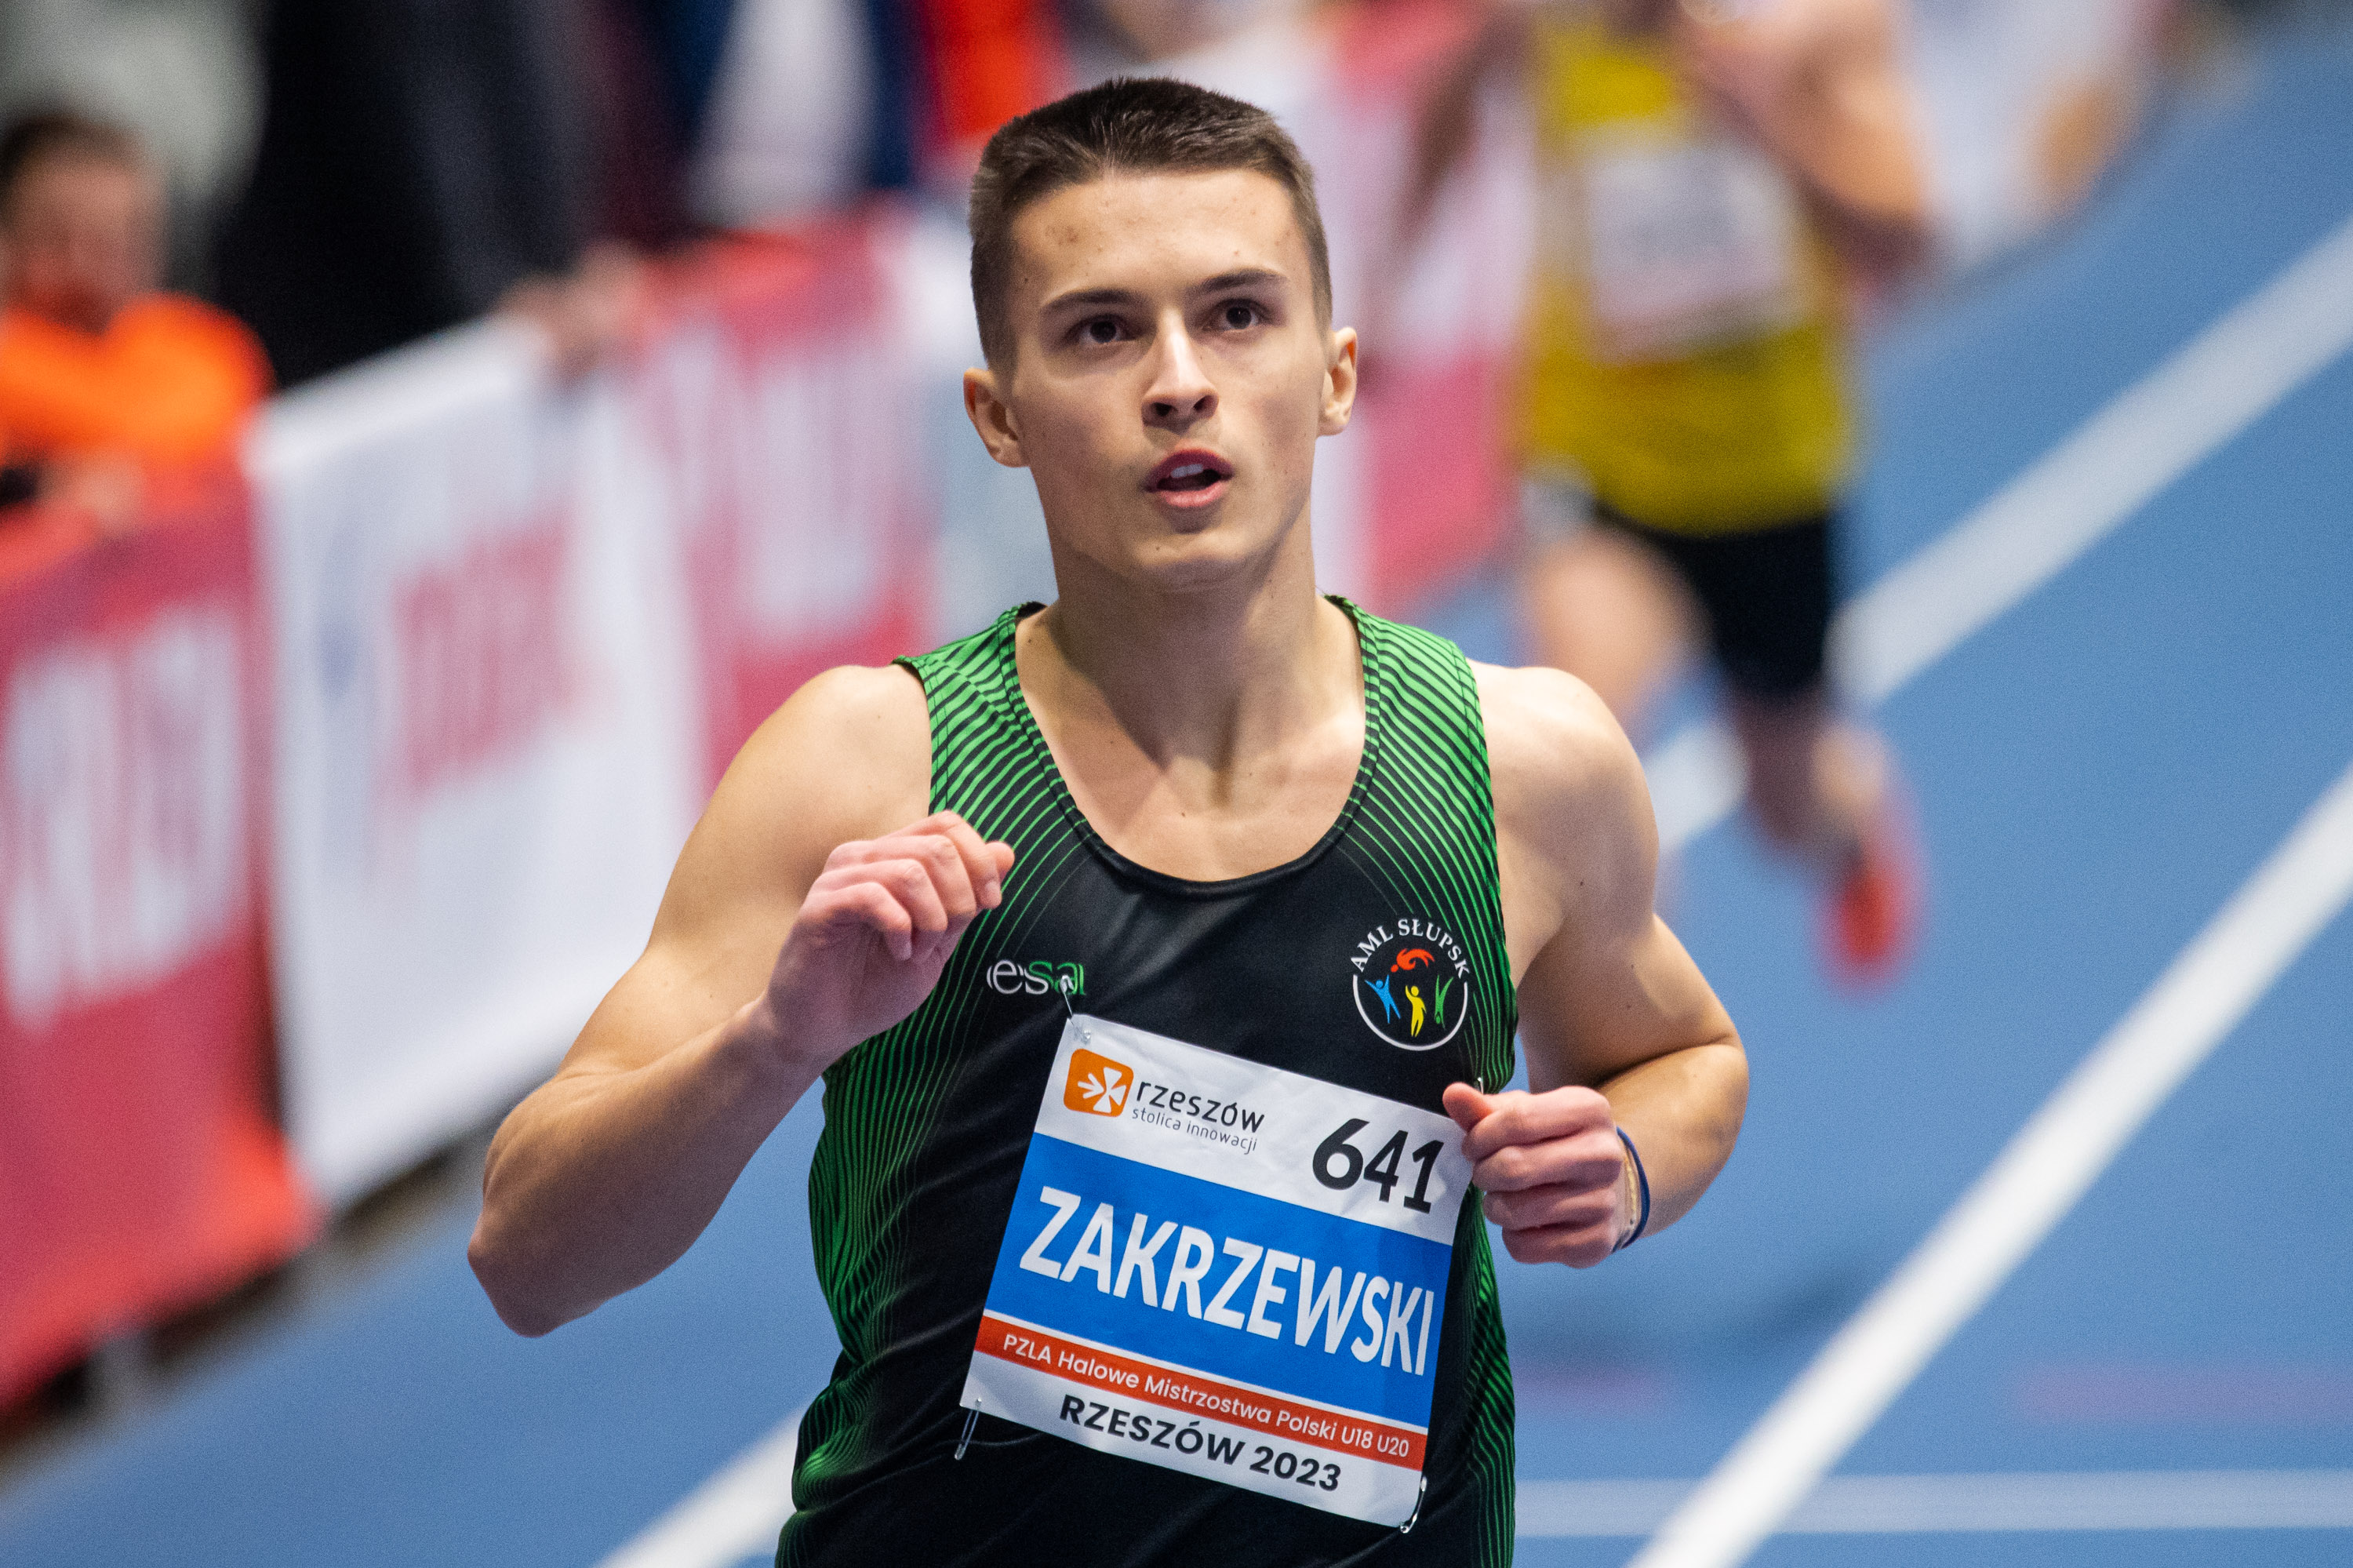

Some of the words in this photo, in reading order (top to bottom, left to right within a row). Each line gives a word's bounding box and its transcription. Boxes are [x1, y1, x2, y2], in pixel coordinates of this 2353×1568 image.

[1351, 925, 1394, 973] AML
[1398, 918, 1470, 979] SŁUPSK
[1132, 1108, 1181, 1130] stolica
[1187, 1120, 1257, 1155] innowacji
[1136, 1082, 1264, 1133] rzeszów
[1312, 1118, 1444, 1214] 641
[1020, 1186, 1435, 1377] ZAKRZEWSKI
[1003, 1333, 1051, 1364] PZLA
[1058, 1351, 1139, 1388] Halowe
[1144, 1376, 1271, 1424] Mistrzostwa
[1276, 1410, 1337, 1441] Polski
[1341, 1426, 1373, 1449] U18
[1377, 1435, 1409, 1457] U20
[1060, 1394, 1246, 1465] RZESZÓW
[1249, 1446, 1341, 1491] 2023
